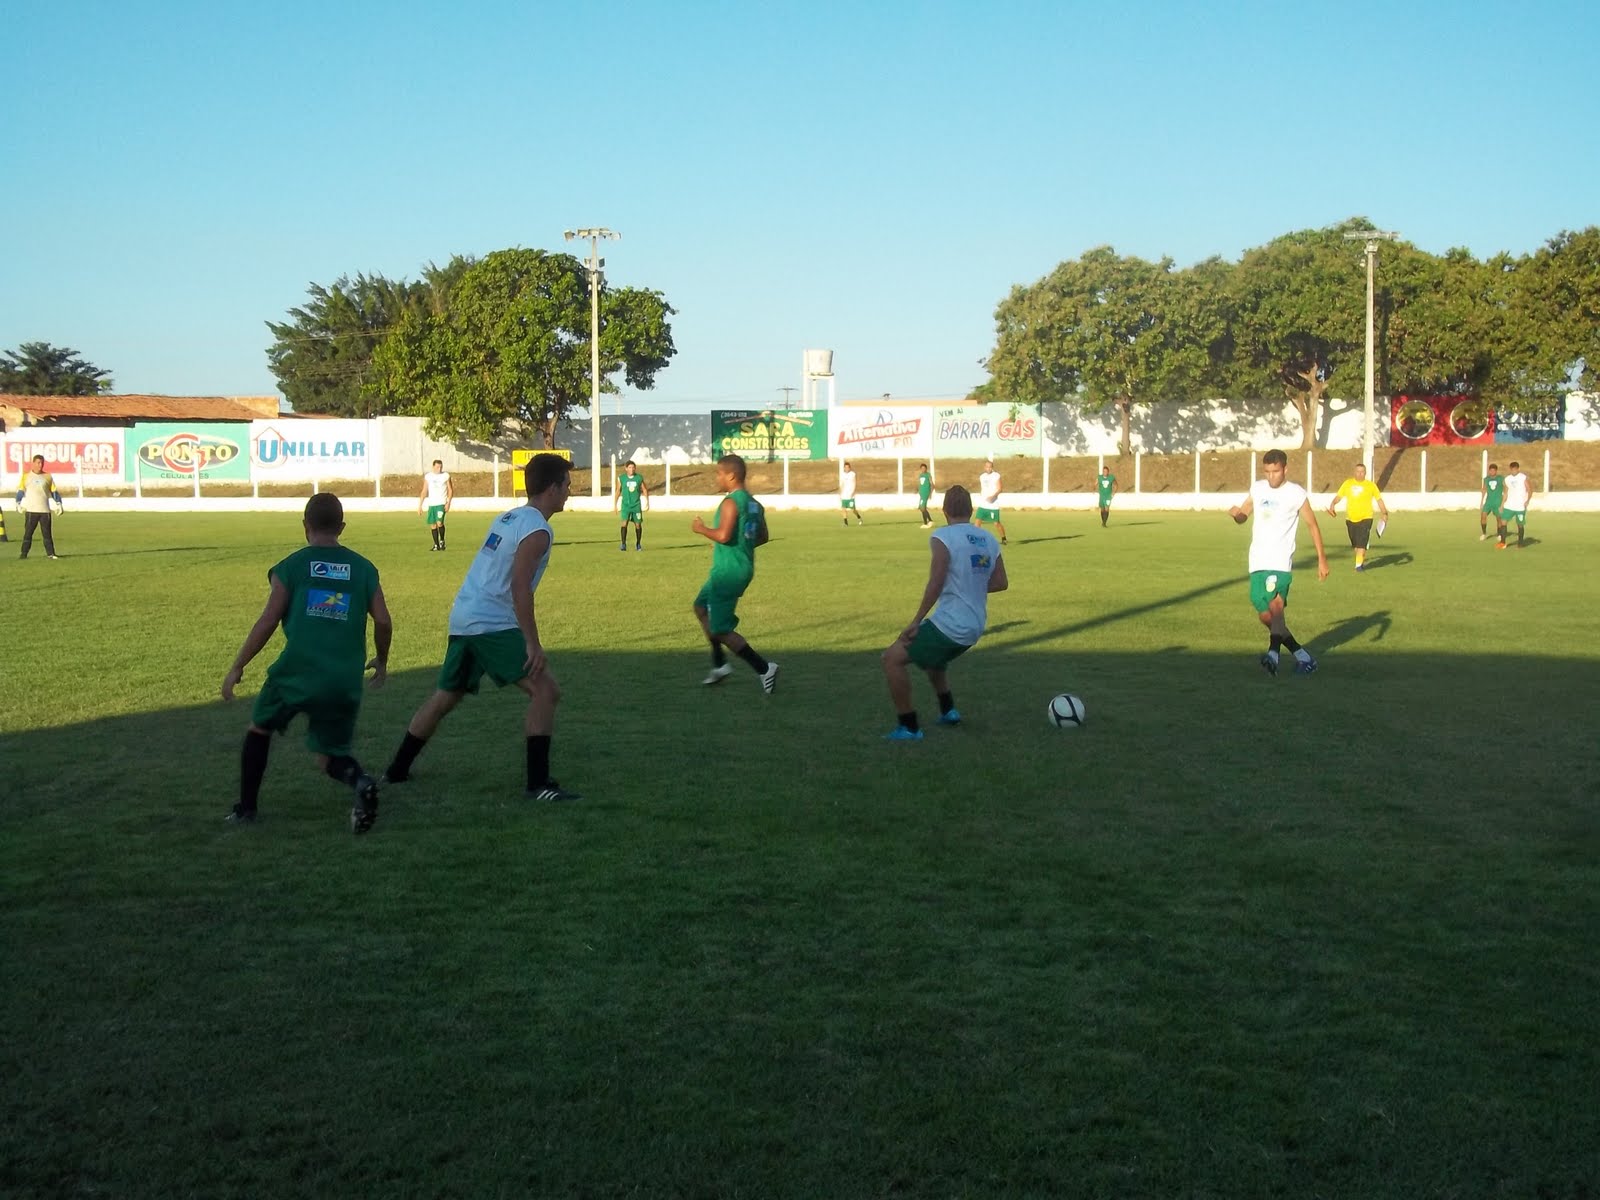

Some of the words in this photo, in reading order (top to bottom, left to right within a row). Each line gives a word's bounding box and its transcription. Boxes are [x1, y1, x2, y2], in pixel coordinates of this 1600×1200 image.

[740, 421, 795, 437] SARA
[939, 420, 991, 440] BARRA
[9, 442, 115, 463] SINGULAR
[147, 443, 232, 461] PONTO
[259, 439, 366, 463] UNILLAR
[160, 472, 210, 480] CELULAES
